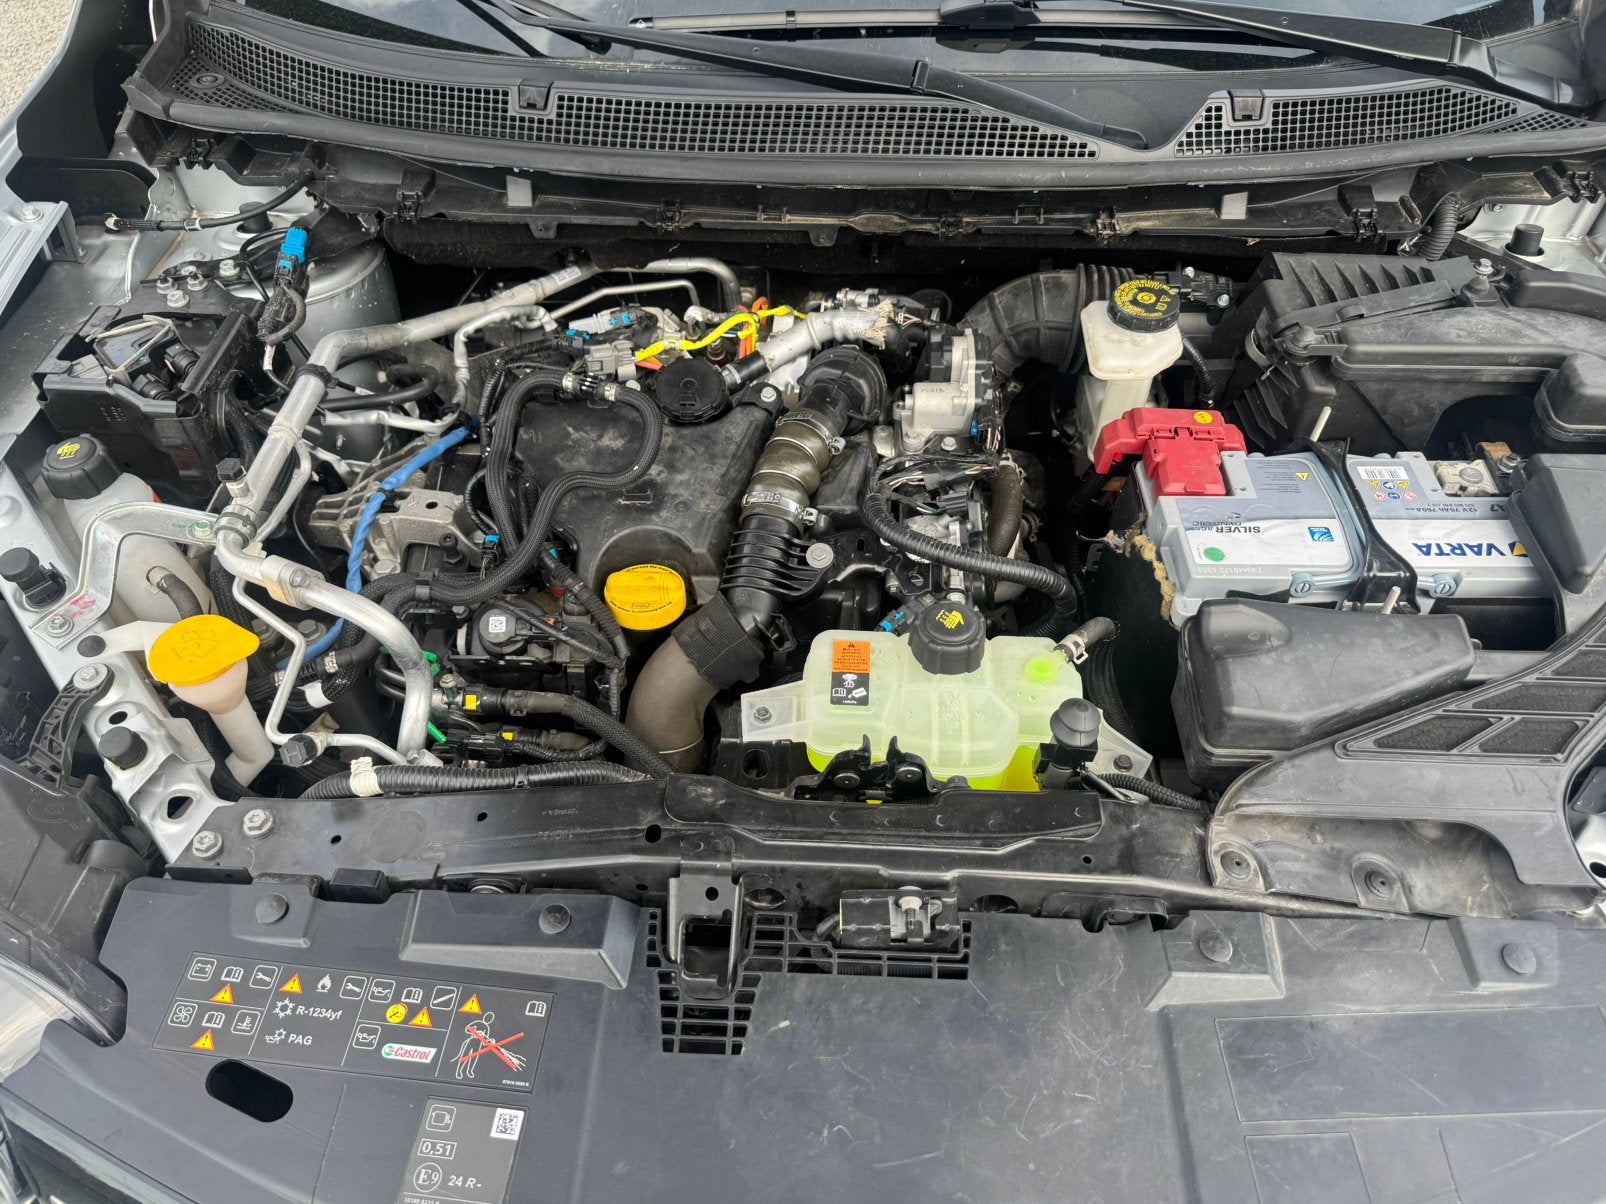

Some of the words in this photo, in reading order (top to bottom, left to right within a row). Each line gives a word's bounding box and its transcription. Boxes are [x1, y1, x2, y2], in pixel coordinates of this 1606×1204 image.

[1215, 526, 1261, 534] SILVER
[1411, 542, 1507, 557] VARTA
[296, 1005, 344, 1021] R-1234yf
[288, 1033, 313, 1045] PAG
[394, 1045, 431, 1061] Castrol
[422, 1141, 452, 1156] 0,51
[447, 1174, 463, 1187] 24
